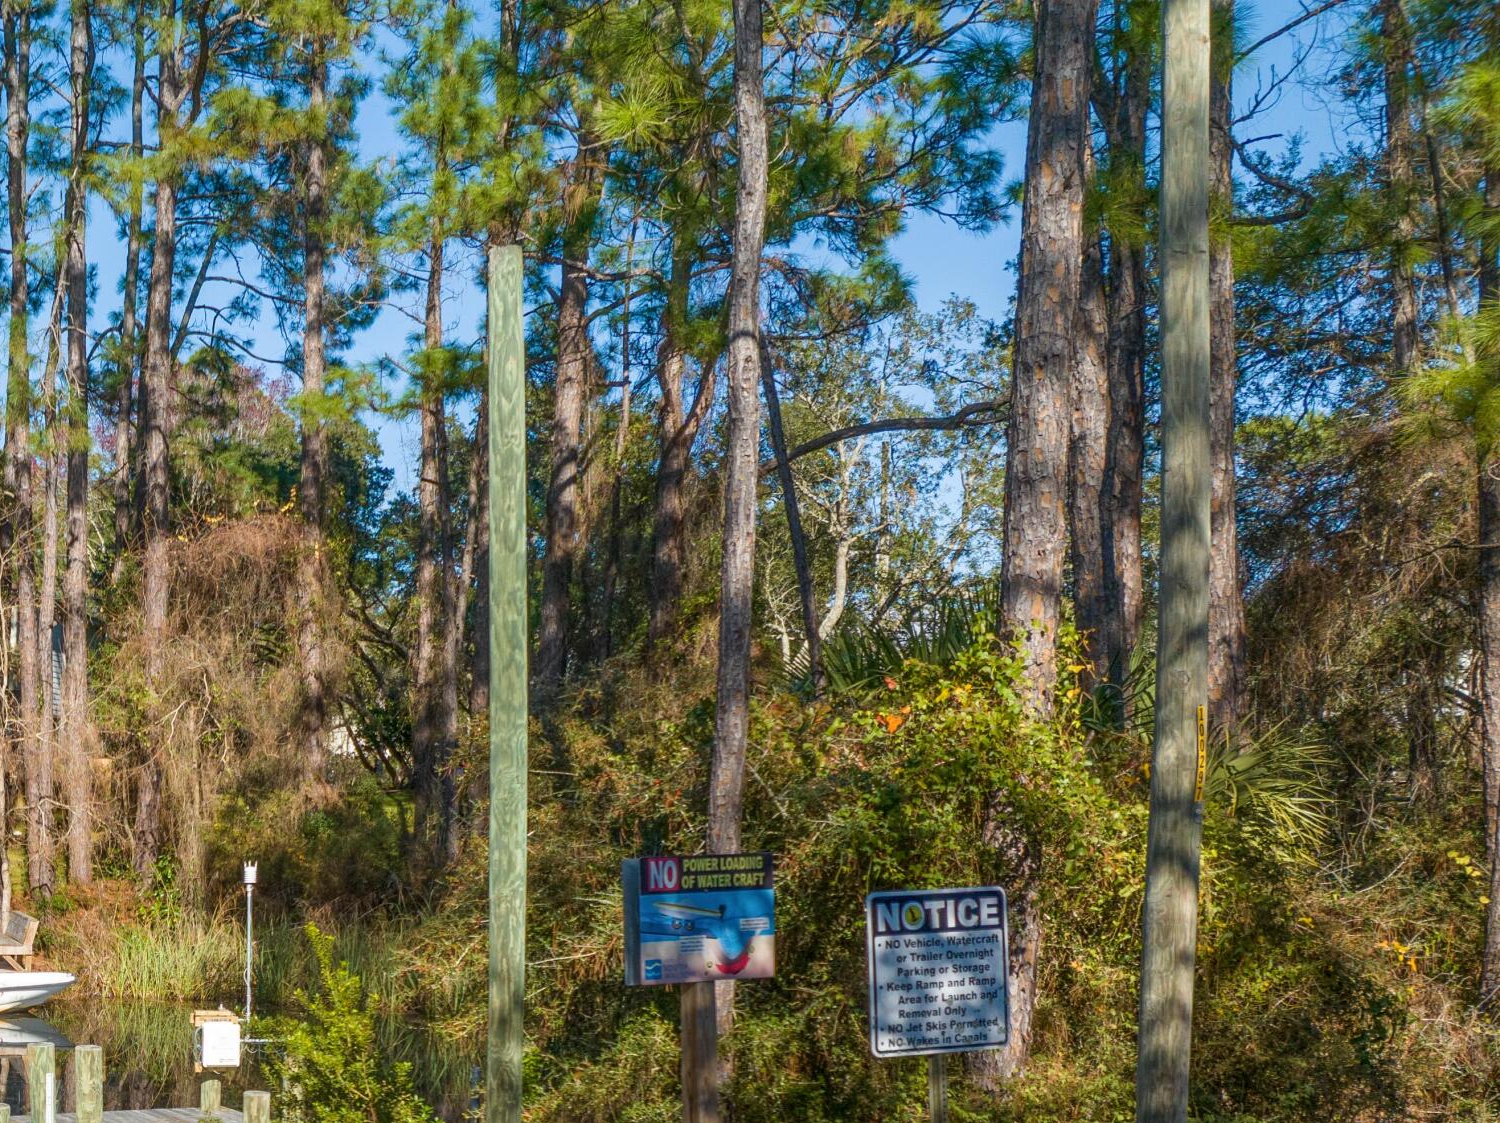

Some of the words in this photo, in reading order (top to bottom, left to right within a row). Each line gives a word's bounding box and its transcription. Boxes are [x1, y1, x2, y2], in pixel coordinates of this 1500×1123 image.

[683, 858, 718, 872] POWER
[720, 856, 763, 870] LOADING
[649, 860, 677, 889] NO
[681, 875, 695, 889] OF
[697, 874, 731, 888] WATER
[733, 872, 764, 886] CRAFT
[876, 897, 1000, 932] NOTICE
[885, 940, 901, 949] NO
[904, 937, 944, 949] Vehicle,
[946, 934, 999, 946] Watercraft
[896, 955, 907, 963] or
[910, 951, 942, 962] Trailer
[946, 949, 994, 960] Overnight
[897, 967, 935, 977] Parking
[938, 966, 948, 974] or
[952, 963, 990, 974] Storage
[886, 981, 913, 992] Keep
[916, 979, 944, 990] Ramp
[948, 978, 965, 987] and
[968, 976, 996, 987] Ramp
[898, 995, 921, 1005] Area
[924, 994, 938, 1003] for
[942, 992, 977, 1002] Launch
[980, 990, 997, 1000] and
[899, 1008, 941, 1018] Removal
[944, 1006, 967, 1017] Only
[888, 1023, 903, 1032] NO
[906, 1022, 922, 1031] Jet
[925, 1020, 947, 1031] Skis
[950, 1017, 998, 1029] Permitted
[888, 1038, 903, 1047] NO
[907, 1035, 940, 1046] Wakes
[942, 1034, 951, 1043] in
[954, 1032, 988, 1043] Canals
